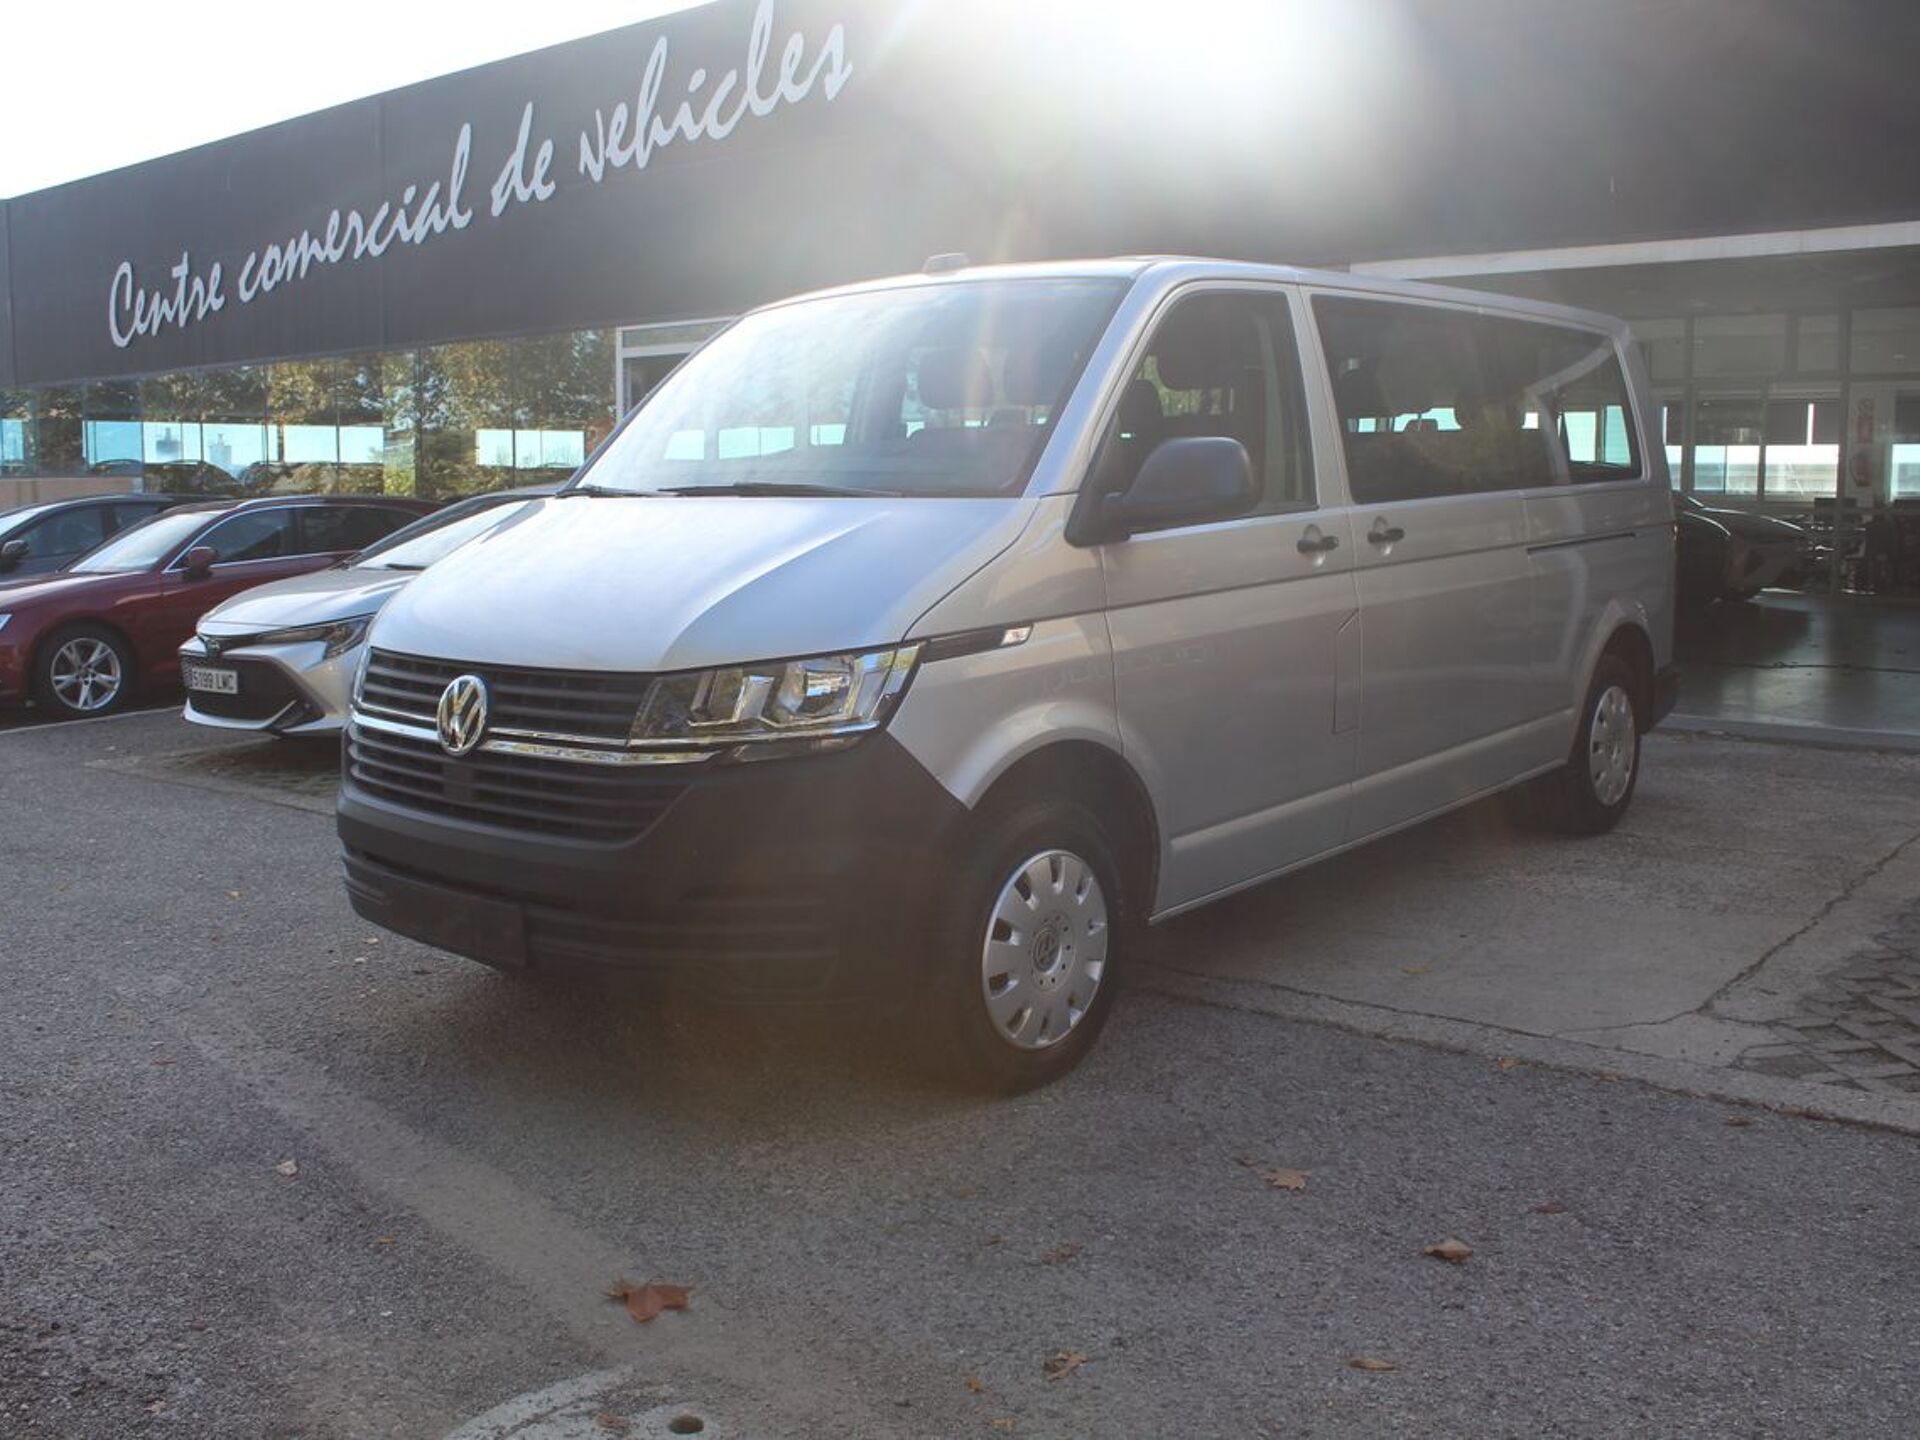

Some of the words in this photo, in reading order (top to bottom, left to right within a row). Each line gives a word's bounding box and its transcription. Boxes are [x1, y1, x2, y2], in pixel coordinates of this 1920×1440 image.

[109, 251, 225, 349] Centre
[238, 122, 473, 302] comercial
[490, 101, 556, 217] de
[579, 0, 853, 182] vehicles
